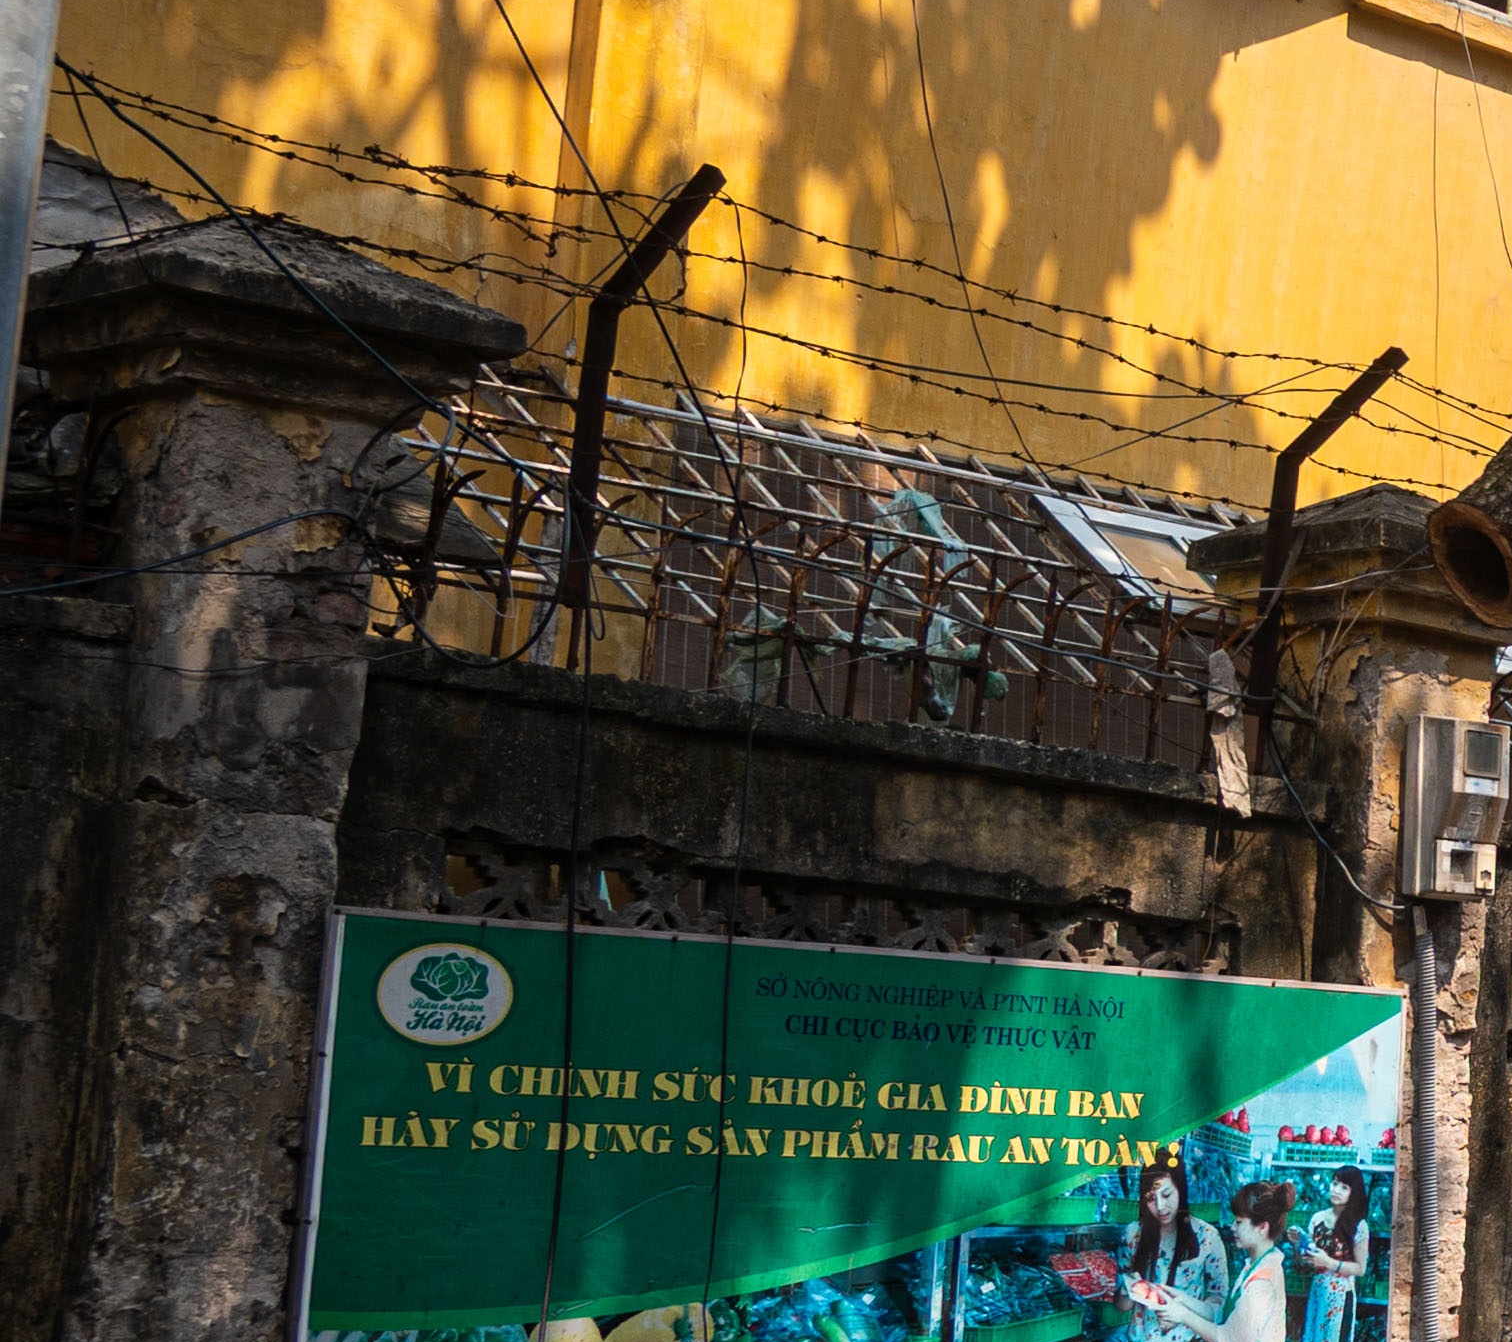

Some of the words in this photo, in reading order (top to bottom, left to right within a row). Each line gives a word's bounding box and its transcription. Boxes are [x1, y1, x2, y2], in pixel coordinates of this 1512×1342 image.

[756, 973, 788, 997] SỞ
[793, 977, 860, 1001] NÔNG
[866, 981, 954, 1010] NGHIỆP
[958, 985, 987, 1009] VÀ
[993, 992, 1048, 1016] PTNT
[1053, 992, 1081, 1017] HÀ
[1086, 997, 1125, 1021] NỘI
[406, 1008, 444, 1031] Hà
[445, 1012, 486, 1037] Nội
[784, 1014, 829, 1036] CHI
[834, 1016, 886, 1042] CỤC
[891, 1012, 940, 1044] BẢO
[945, 1017, 977, 1045] VỆ
[983, 1025, 1047, 1051] THỰC
[1050, 1024, 1097, 1055] VẬT
[425, 1057, 478, 1093] VÌ
[652, 1065, 738, 1105] SỨC
[747, 1072, 867, 1109] KHOẺ
[877, 1081, 949, 1113] GIA
[958, 1080, 1059, 1116] ĐÌNH
[1066, 1089, 1145, 1125] BẠN
[470, 1111, 537, 1151] SỬ
[544, 1121, 674, 1160] DỤNG
[685, 1117, 774, 1157] SẢN
[780, 1118, 900, 1160] PHẨM
[909, 1133, 996, 1163] RAU
[1000, 1135, 1055, 1165] AN
[1060, 1133, 1161, 1168] TOÀN
